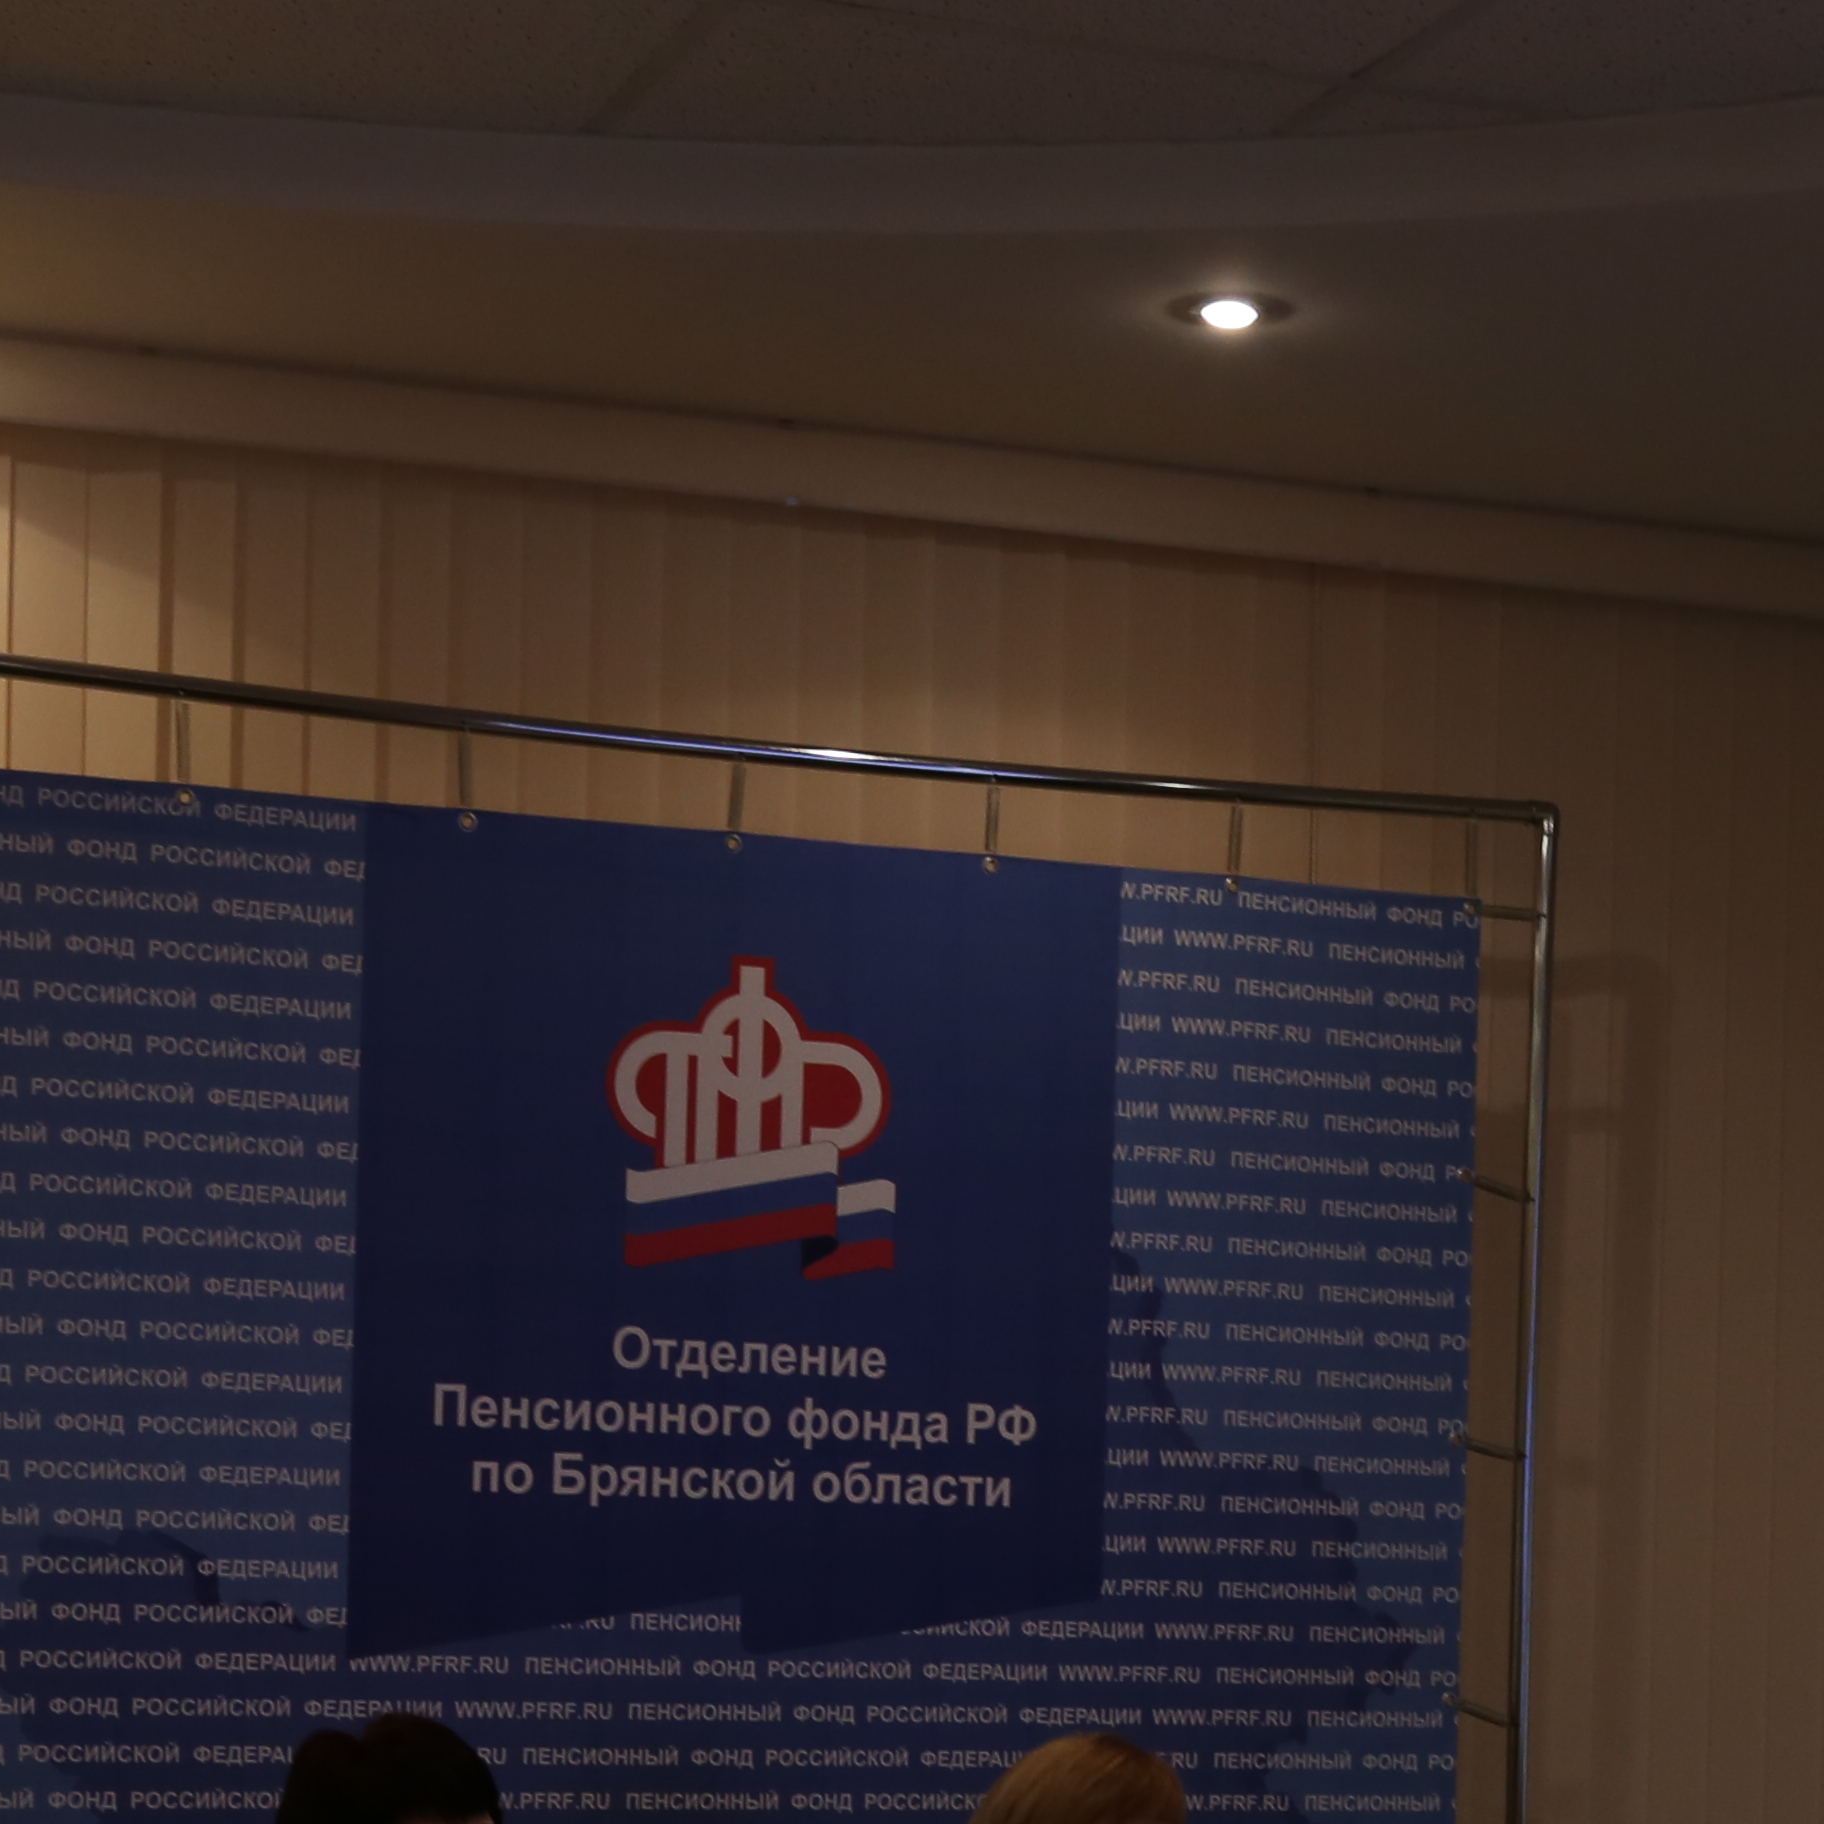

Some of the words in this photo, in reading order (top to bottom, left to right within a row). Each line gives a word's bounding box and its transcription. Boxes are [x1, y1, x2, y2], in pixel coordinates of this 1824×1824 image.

[213, 803, 357, 832] ФЕДЕРАЦИИ
[67, 839, 139, 863] ФОНД
[150, 844, 312, 875] РОССИЙСКОЙ
[36, 885, 199, 913] РОССИЙСКОЙ
[211, 898, 355, 926] ФЕДЕРАЦИИ
[64, 935, 136, 959] ФОНД
[148, 940, 309, 969] РОССИЙСКОЙ
[1173, 929, 1314, 958] WWW.PFRF.RU
[33, 981, 197, 1008] РОССИЙСКОЙ
[209, 993, 352, 1021] ФЕДЕРАЦИИ
[1234, 977, 1374, 1006] ПЕНСИОННЫЙ
[1170, 1017, 1312, 1044] WWW.PFRF.RU
[62, 1031, 134, 1054] ФОНД
[146, 1035, 307, 1063] РОССИЙСКОЙ
[1232, 1064, 1372, 1091] ПЕНСИОННЫЙ
[31, 1077, 195, 1104] РОССИЙСКОЙ
[206, 1088, 350, 1115] ФЕДЕРАЦИИ
[1168, 1104, 1309, 1130] WWW.PFRF.RU
[1323, 1114, 1461, 1139] ПЕНСИОННЫЙ
[60, 1127, 131, 1150] ФОНД
[143, 1131, 305, 1157] РОССИЙСКОЙ
[1230, 1151, 1370, 1176] ПЕНСИОННЫЙ
[29, 1173, 193, 1199] РОССИЙСКОЙ
[205, 1183, 348, 1208] ФЕДЕРАЦИИ
[1166, 1190, 1307, 1216] WWW.PFRF.RU
[1320, 1199, 1458, 1224] ПЕНСИОННЫЙ
[58, 1223, 130, 1245] ФОНД
[141, 1226, 303, 1251] РОССИЙСКОЙ
[1227, 1237, 1367, 1261] ПЕНСИОННЫЙ
[27, 1269, 191, 1294] РОССИЙСКОЙ
[202, 1277, 346, 1302] ФЕДЕРАЦИИ
[1163, 1277, 1304, 1301] WWW.PFRF.RU
[1318, 1285, 1455, 1308] ПЕНСИОННЫЙ
[56, 1318, 128, 1341] ФОНД
[139, 1321, 300, 1345] РОССИЙСКОЙ
[1225, 1323, 1365, 1347] ПЕНСИОННЫЙ
[1373, 1331, 1430, 1352] ФОНД
[613, 1325, 887, 1379] Отделение
[24, 1364, 189, 1388] РОССИЙСКОЙ
[200, 1372, 343, 1395] ФЕДЕРАЦИИ
[1161, 1364, 1302, 1387] WWW.PFRF.RU
[1316, 1370, 1453, 1393] ПЕНСИОННЫЙ
[54, 1413, 126, 1436] ФОНД
[137, 1415, 298, 1439] РОССИЙСКОЙ
[434, 1383, 771, 1438] Пенсионного
[787, 1396, 949, 1450] фонда
[966, 1402, 1037, 1446] РФ
[1222, 1409, 1363, 1432] ПЕНСИОННЫЙ
[23, 1460, 187, 1483] РОССИЙСКОЙ
[198, 1465, 341, 1488] ФЕДЕРАЦИИ
[1158, 1450, 1300, 1472] WWW.PFRF.RU
[1313, 1455, 1451, 1477] ПЕНСИОННЫЙ
[472, 1460, 534, 1494] по
[552, 1451, 795, 1507] Брянской
[812, 1460, 1011, 1508] области
[52, 1508, 124, 1530] ФОНД
[135, 1510, 296, 1532] РОССИЙСКОЙ
[1219, 1495, 1360, 1517] ПЕНСИОННЫЙ
[1368, 1501, 1426, 1521] ФОНД
[1155, 1536, 1297, 1558] WWW.PFRF.RU
[1310, 1540, 1448, 1561] ПЕНСИОННЫЙ
[21, 1554, 186, 1577] РОССИЙСКОЙ
[195, 1559, 339, 1582] ФЕДЕРАЦИИ
[1217, 1581, 1358, 1602] ПЕНСИОННЫЙ
[1365, 1585, 1424, 1605] ФОНД
[49, 1602, 123, 1625] ФОНД
[133, 1603, 295, 1626] РОССИЙСКОЙ
[1019, 1619, 1146, 1642] ФЕДЕРАЦИИ
[1153, 1622, 1295, 1643] WWW.PFRF.RU
[1308, 1625, 1446, 1645] ПЕНСИОННЫЙ
[18, 1649, 183, 1671] РОССИЙСКОЙ
[194, 1652, 337, 1675] ФЕДЕРАЦИИ
[348, 1654, 510, 1676] WWW.PFRF.RU
[523, 1656, 683, 1678] ПЕНСИОННЫЙ
[691, 1659, 758, 1681] ФОНД
[766, 1659, 913, 1681] РОССИЙСКОЙ
[921, 1662, 1049, 1684] ФЕДЕРАЦИИ
[1057, 1664, 1202, 1685] WWW.PFRF.RU
[1215, 1666, 1356, 1686] ПЕНСИОННЫЙ
[47, 1696, 121, 1719] ФОНД
[130, 1697, 293, 1719] РОССИЙСКОЙ
[453, 1700, 614, 1722] WWW.PFRF.RU
[627, 1702, 783, 1723] ПЕНСИОННЫЙ
[791, 1704, 857, 1726] ФОНД
[865, 1704, 1009, 1725] РОССИЙСКОЙ
[1017, 1706, 1143, 1727] ФЕДЕРАЦИИ
[1151, 1708, 1293, 1728] WWW.PFRF.RU
[1306, 1710, 1444, 1729] ПЕНСИОННЫЙ
[17, 1742, 181, 1765] РОССИЙСКОЙ
[521, 1746, 680, 1767] ПЕНСИОННЫЙ
[689, 1748, 756, 1770] ФОНД
[764, 1747, 910, 1769] РОССИЙСКОЙ
[1212, 1751, 1353, 1771] ПЕНСИОННЫЙ
[46, 1790, 119, 1813] ФОНД
[624, 1791, 781, 1812] ПЕНСИОННЫЙ
[789, 1792, 854, 1813] ФОНД
[1303, 1794, 1442, 1813] ПЕНСИОННЫЙ
